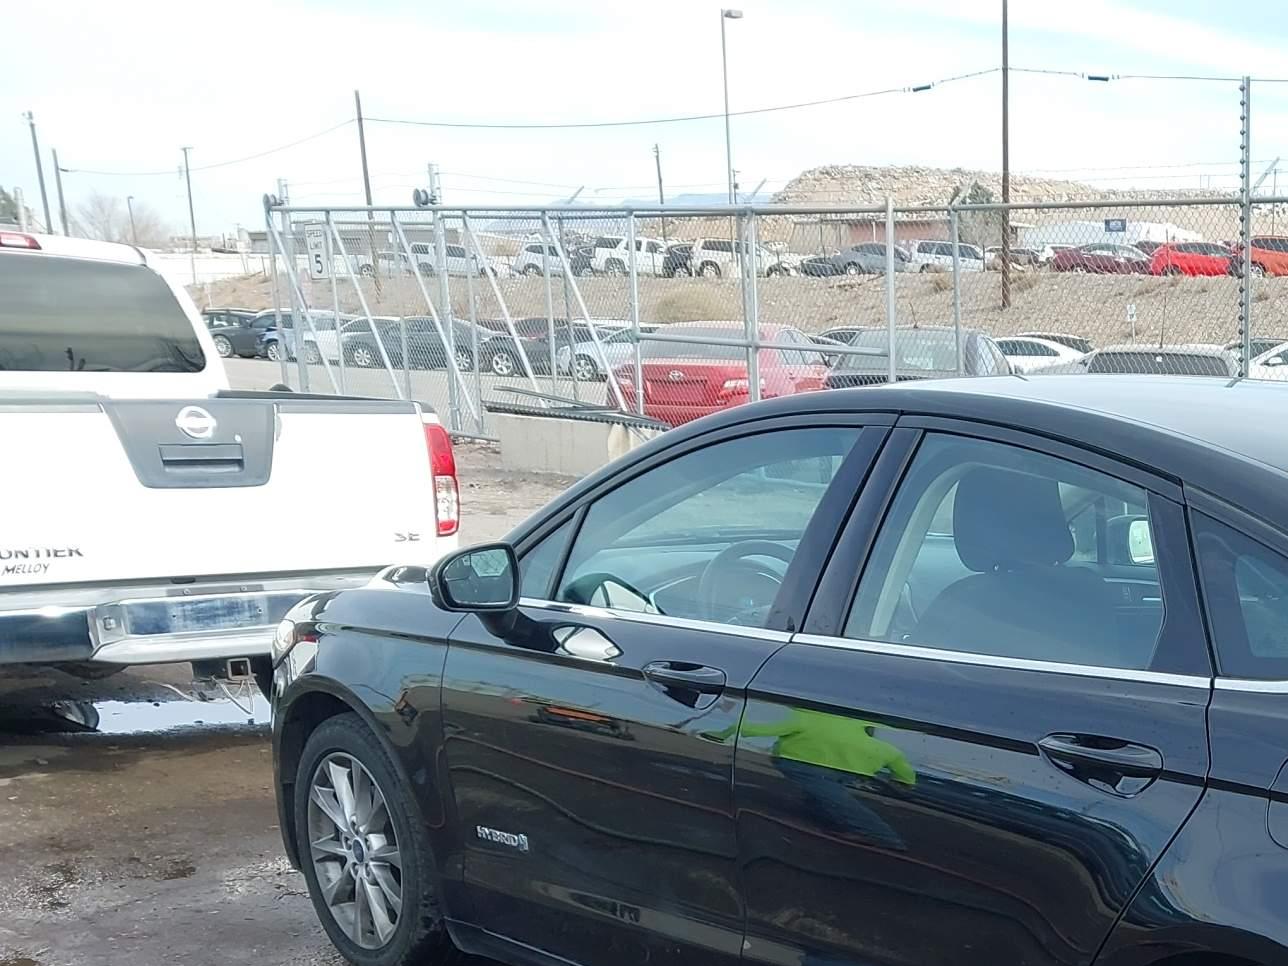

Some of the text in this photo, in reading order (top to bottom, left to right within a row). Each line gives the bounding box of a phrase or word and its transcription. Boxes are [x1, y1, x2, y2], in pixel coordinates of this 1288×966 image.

[314, 253, 324, 274] 5
[1, 562, 50, 576] MELLOY
[476, 825, 519, 847] HYBRID
